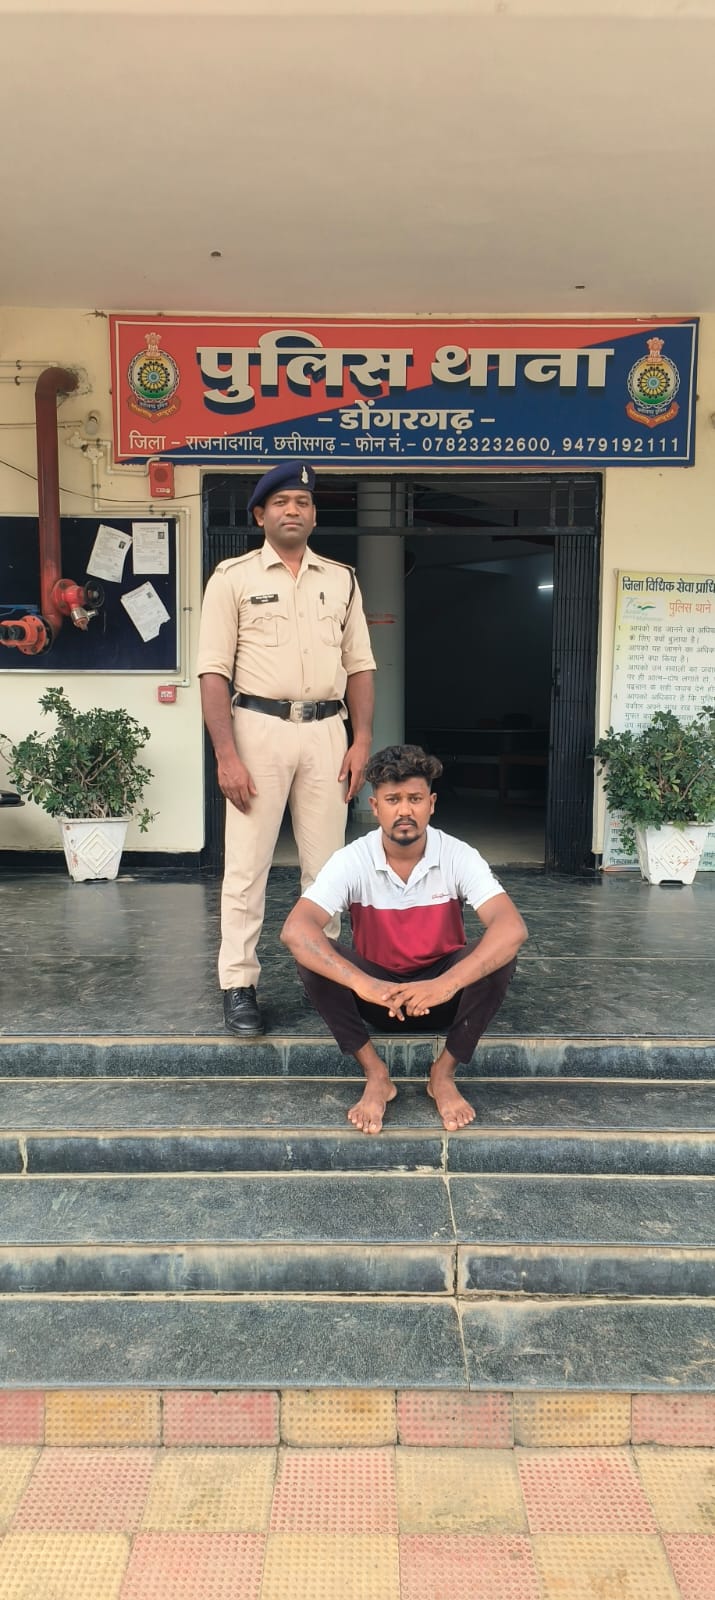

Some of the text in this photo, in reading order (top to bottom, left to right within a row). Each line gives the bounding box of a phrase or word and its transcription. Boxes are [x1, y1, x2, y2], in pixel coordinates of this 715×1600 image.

[196, 329, 614, 408] पुलिस थाना
[339, 400, 474, 434] डोंगरगढ़
[129, 430, 166, 450] जिला
[185, 431, 269, 454] राजनांदगांव,
[273, 432, 336, 454] छत्तीसगढ़
[355, 433, 385, 452] फोन
[422, 437, 556, 455] 07823232600,
[562, 437, 679, 452] 9479192111
[622, 576, 644, 591] जिला
[646, 577, 675, 592] विधिक
[676, 578, 694, 593] सेवा
[669, 599, 692, 616] पुलिस
[695, 600, 712, 613] थाने
